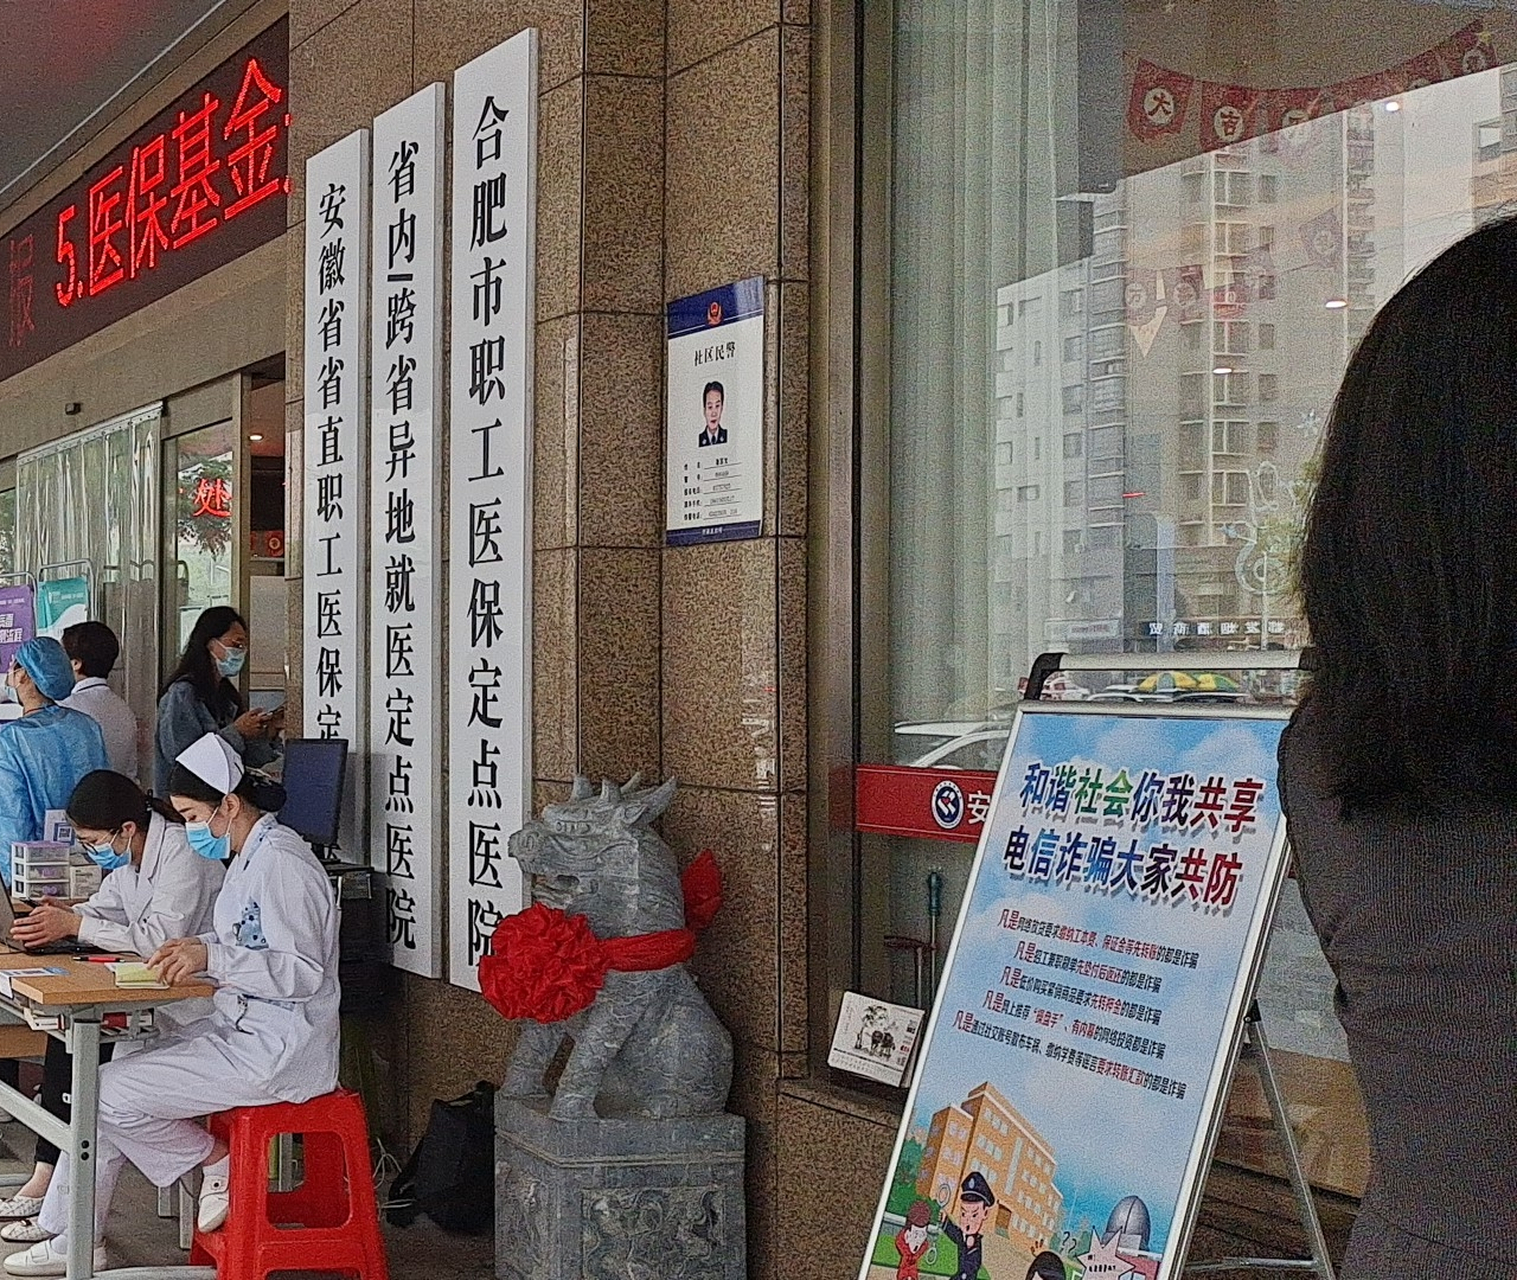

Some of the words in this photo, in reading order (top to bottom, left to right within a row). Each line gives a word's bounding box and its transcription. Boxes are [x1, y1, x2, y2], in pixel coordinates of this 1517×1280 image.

[55, 58, 290, 307] 5.医保基金
[694, 341, 736, 367] 社区民警
[316, 183, 346, 860] 安徽省省直职工医保定
[467, 95, 509, 967] 合肥市职工医保定点医院
[1003, 824, 1243, 907] 电信诈骗大家共防
[1019, 762, 1264, 833] 和谐社会你我共享
